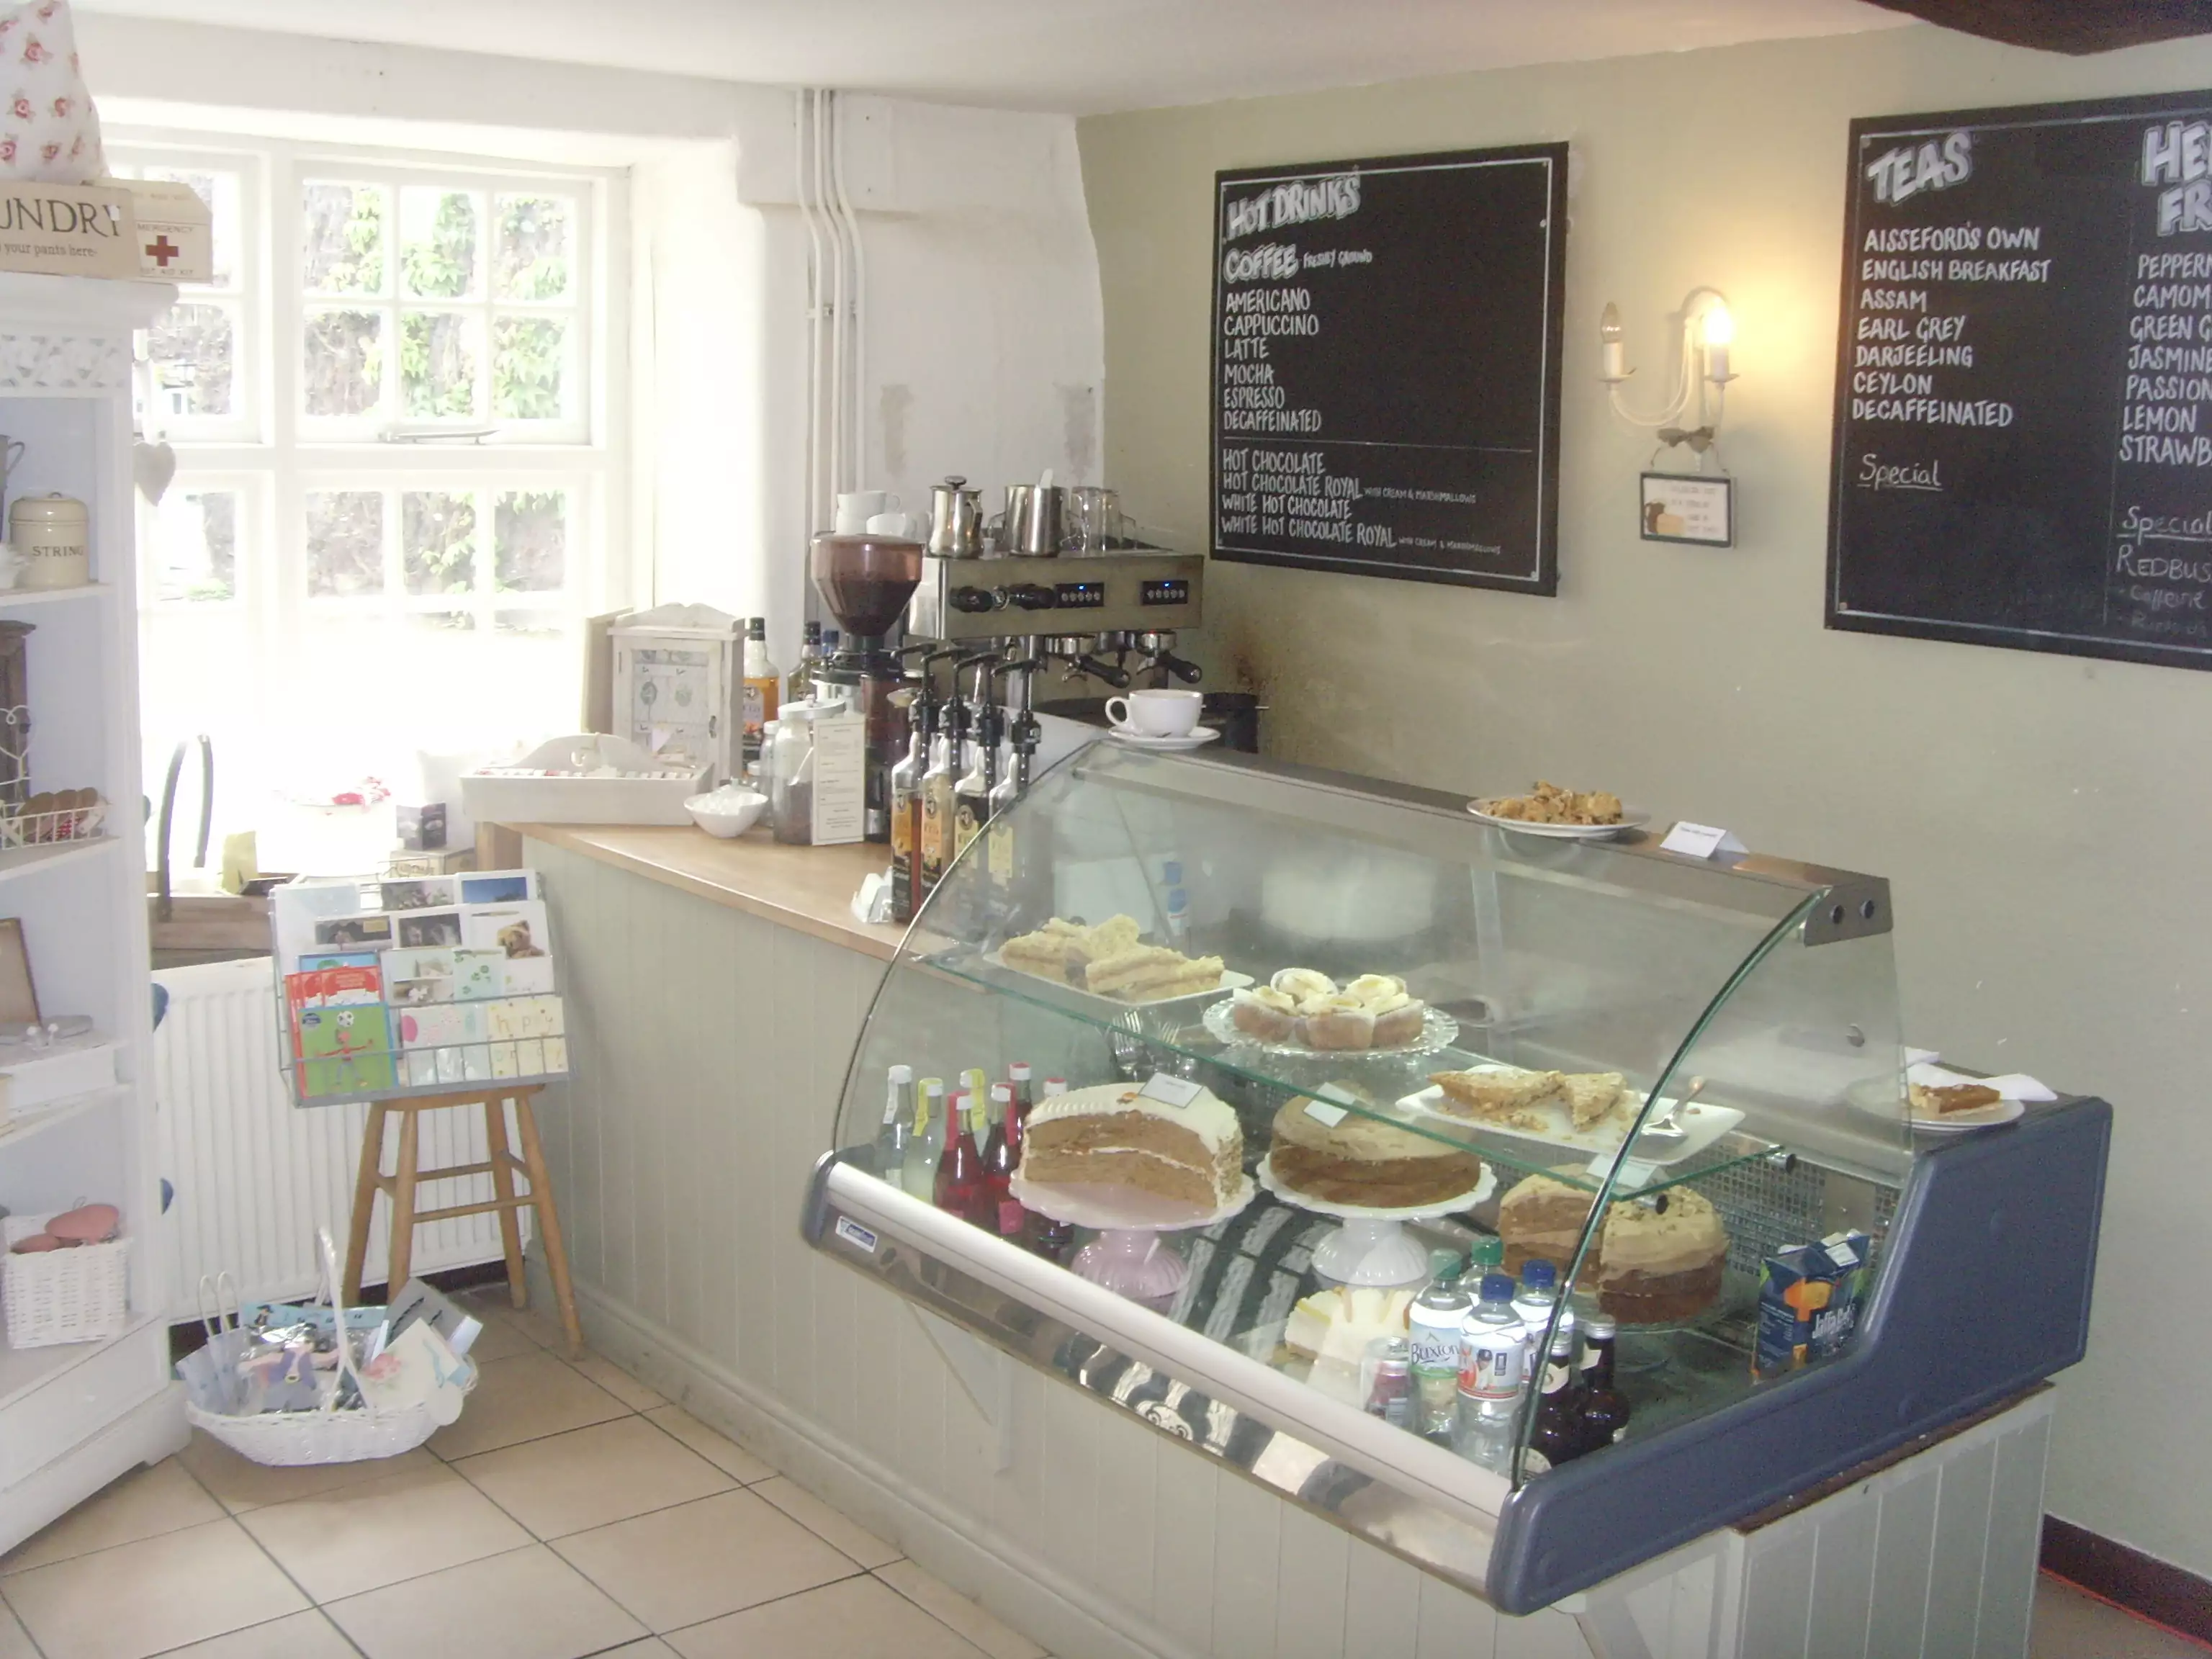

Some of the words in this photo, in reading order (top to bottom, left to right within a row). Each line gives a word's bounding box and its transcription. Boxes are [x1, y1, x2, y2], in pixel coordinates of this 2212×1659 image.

[2141, 120, 2212, 186] HE
[1867, 131, 1972, 207] TEAS
[1227, 188, 1272, 240] HOT
[1272, 175, 1361, 228] DRINKS
[4, 243, 31, 256] your
[34, 245, 66, 257] pants
[1987, 226, 2040, 251] OWN
[1224, 242, 1299, 284] COFFEE
[1861, 258, 1943, 282] ENGLISH
[1948, 258, 2051, 283] BREAKFAST
[1226, 288, 1310, 313] AMERICANO
[1860, 288, 1927, 313] ASSAM
[1224, 314, 1319, 336] CAPPUCCINO
[1857, 317, 1910, 341] EARL
[1916, 315, 1966, 343] GREY
[2129, 314, 2193, 342] GREEN
[1225, 336, 1269, 360] LATTE
[1854, 344, 1973, 367] DARJEELING
[2128, 344, 2212, 373] JASMINE
[1224, 364, 1274, 385] MOCHA
[1853, 371, 1933, 395] CEYLON
[2126, 374, 2212, 401] PASSION
[1224, 386, 1285, 408] ESPRESSO
[1224, 409, 1322, 431] DECAFFEINATED
[1852, 397, 2014, 428] DECAFFEINATED
[2123, 405, 2198, 432] LEMON
[1223, 448, 1249, 470] HOT
[1252, 451, 1326, 474] CHOCOLATE
[2119, 434, 2212, 467] STRAWB
[1859, 453, 1942, 490] Special
[1223, 471, 1248, 490] HOT
[1251, 473, 1321, 496] CHOCOLATE
[1324, 475, 1363, 500] ROYAL
[1222, 493, 1257, 513] WHITE
[1262, 495, 1285, 514] HOT
[1287, 495, 1352, 520] CHOCOLATE
[1221, 515, 1258, 534] WHITE
[1262, 517, 1285, 535] HOT
[1288, 520, 1354, 543] CHOCOLATE
[1357, 523, 1398, 548] ROYAL
[2122, 505, 2212, 545] Special
